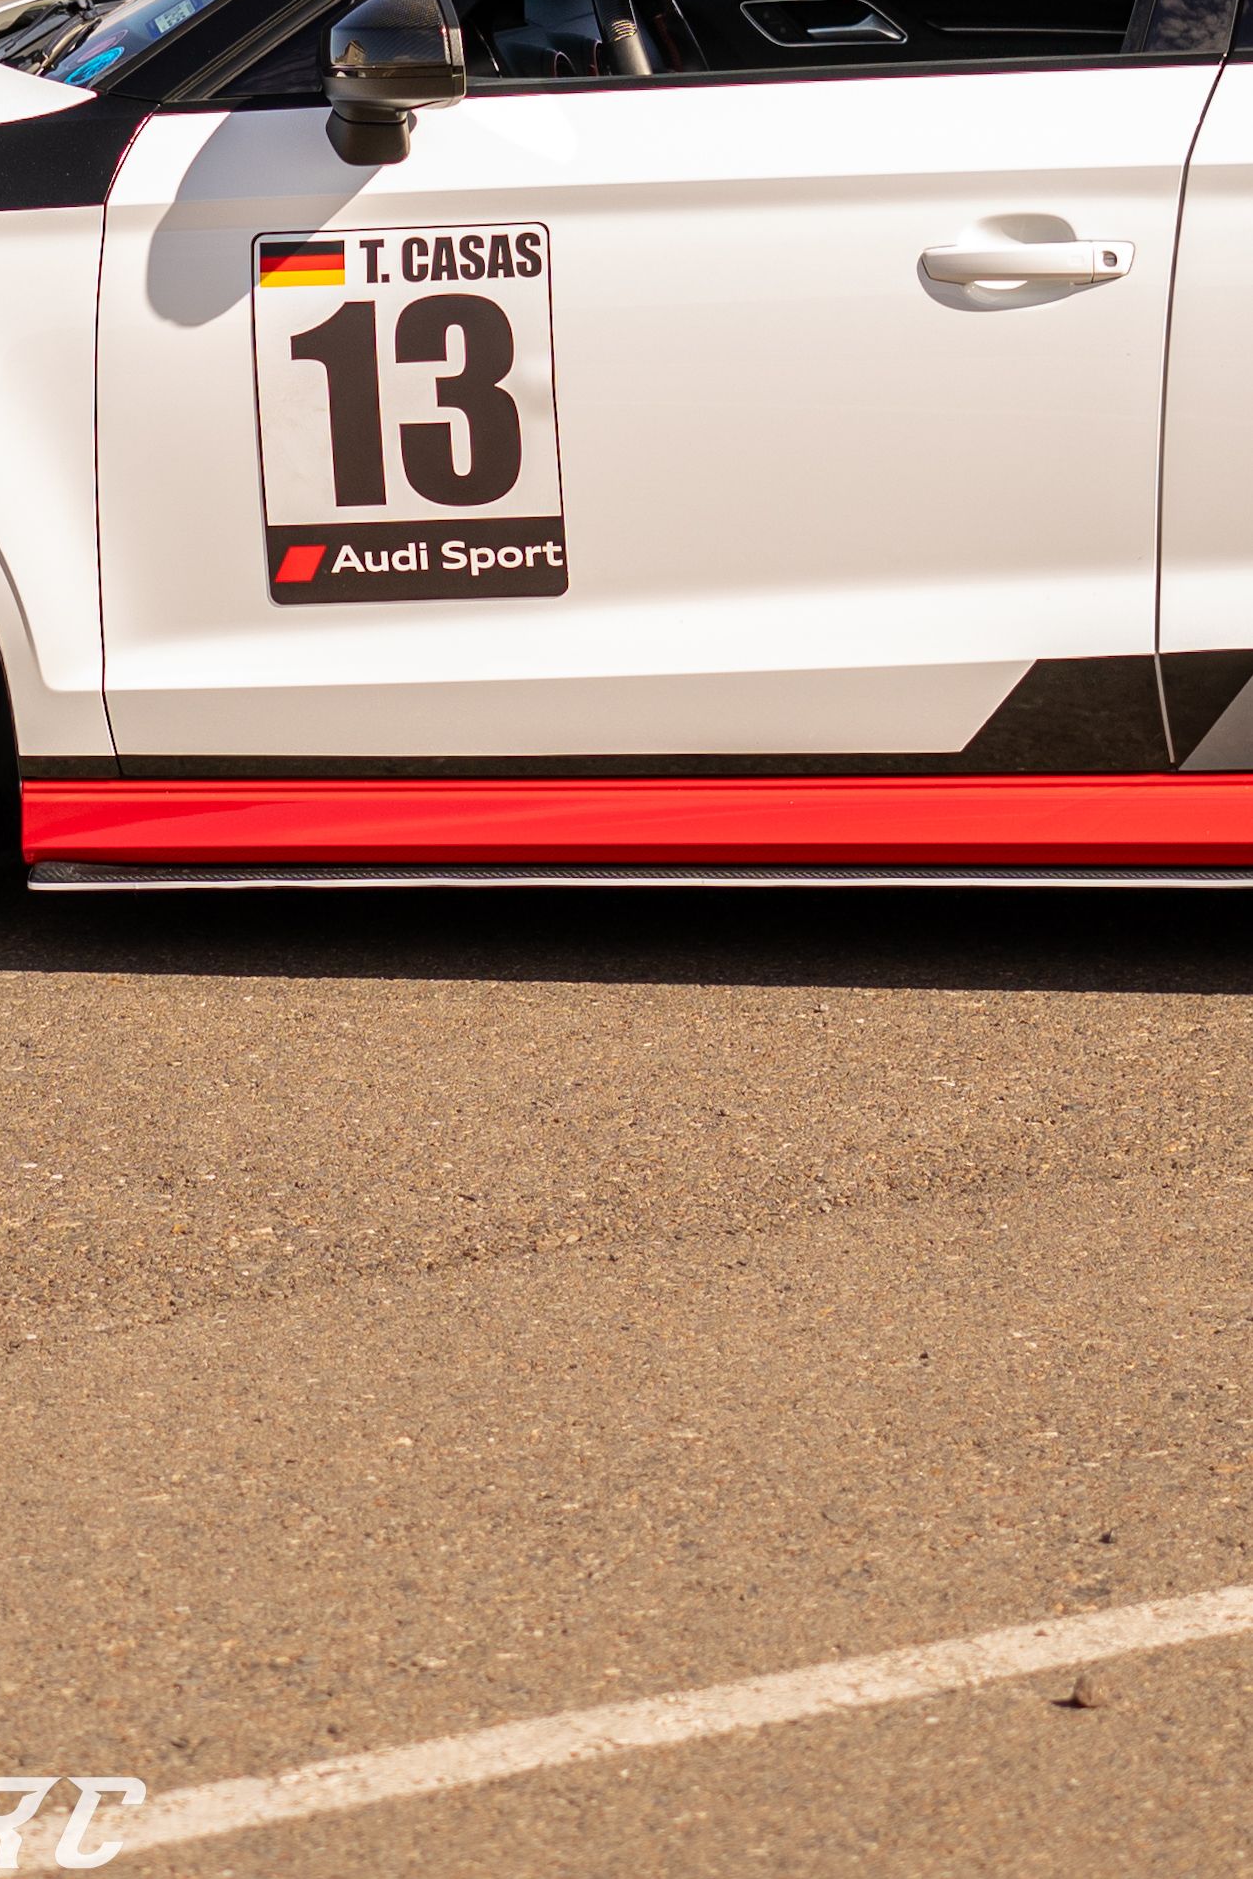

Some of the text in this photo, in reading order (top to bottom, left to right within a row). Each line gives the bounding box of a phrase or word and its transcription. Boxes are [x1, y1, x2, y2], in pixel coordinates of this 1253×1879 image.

[359, 232, 543, 283] T. CASAS
[290, 292, 522, 508] 13
[331, 539, 564, 577] Audi Sport
